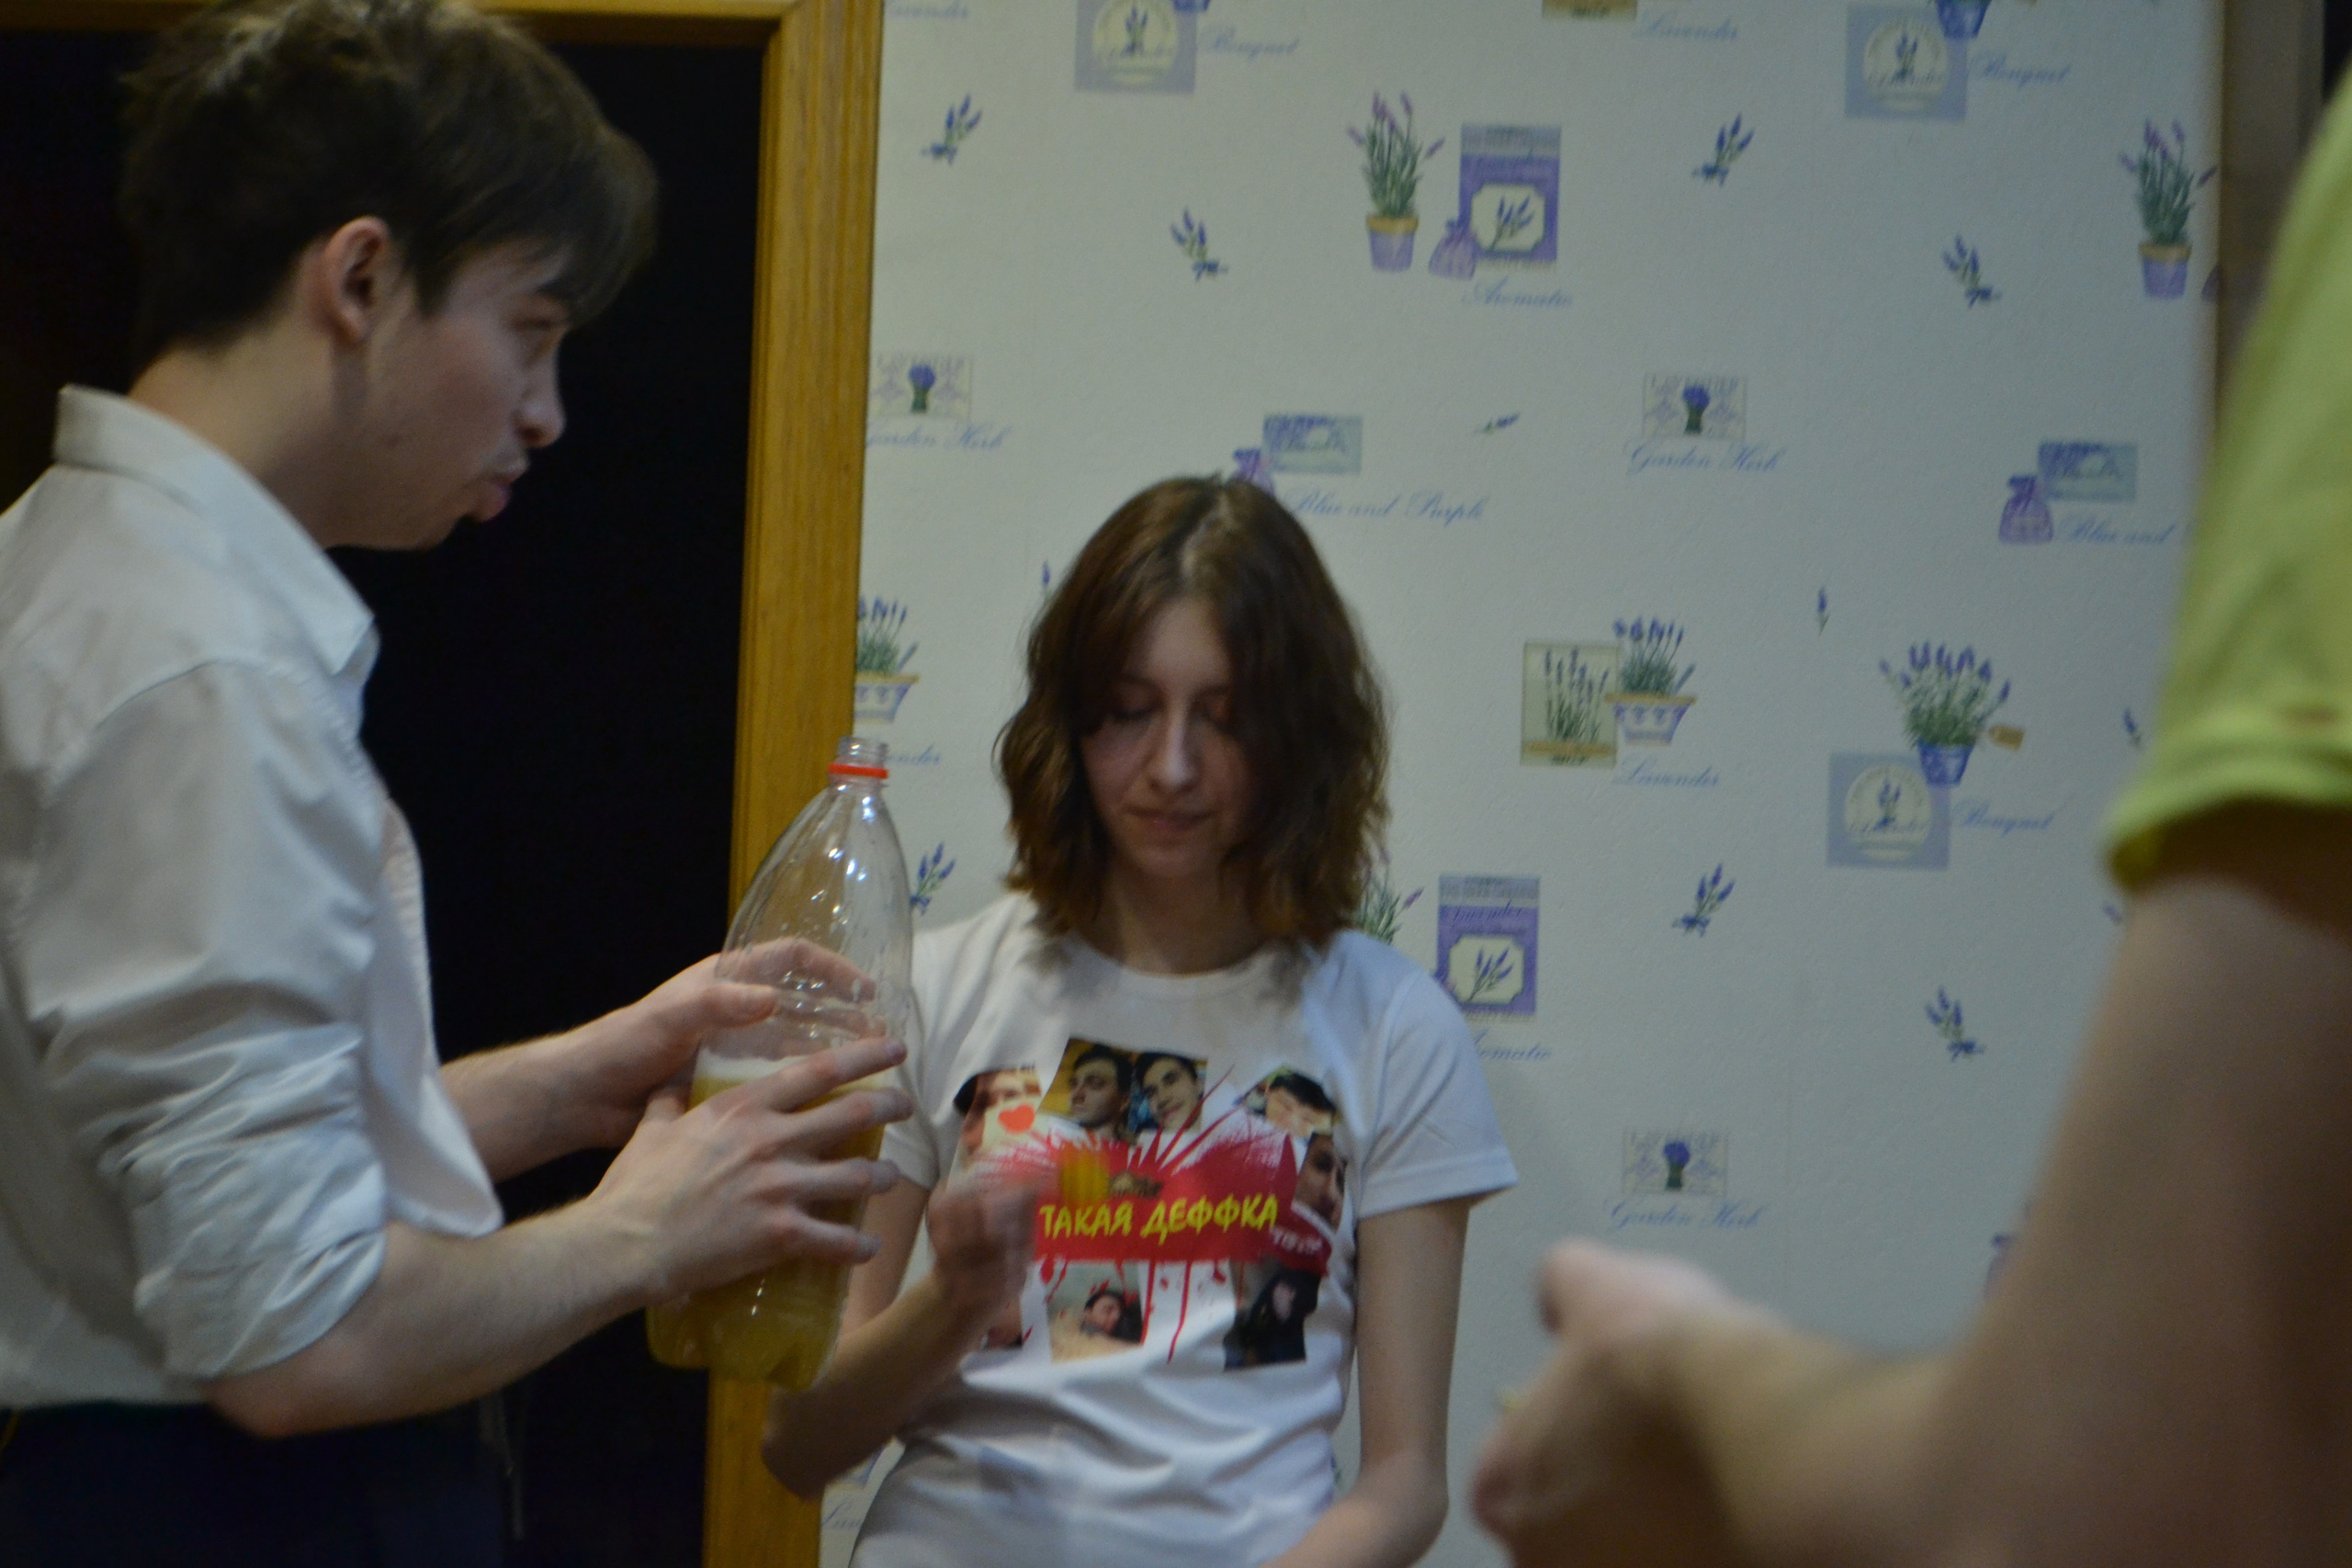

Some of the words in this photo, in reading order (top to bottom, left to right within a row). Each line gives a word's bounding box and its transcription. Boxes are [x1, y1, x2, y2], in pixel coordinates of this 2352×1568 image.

[1624, 443, 1712, 477] Garden
[1347, 493, 1401, 518] and
[1406, 490, 1491, 528] Purple
[1612, 753, 1721, 789] Lavender
[1039, 1200, 1134, 1239] ТАКАЯ
[1139, 1193, 1279, 1246] ДЕФФКА
